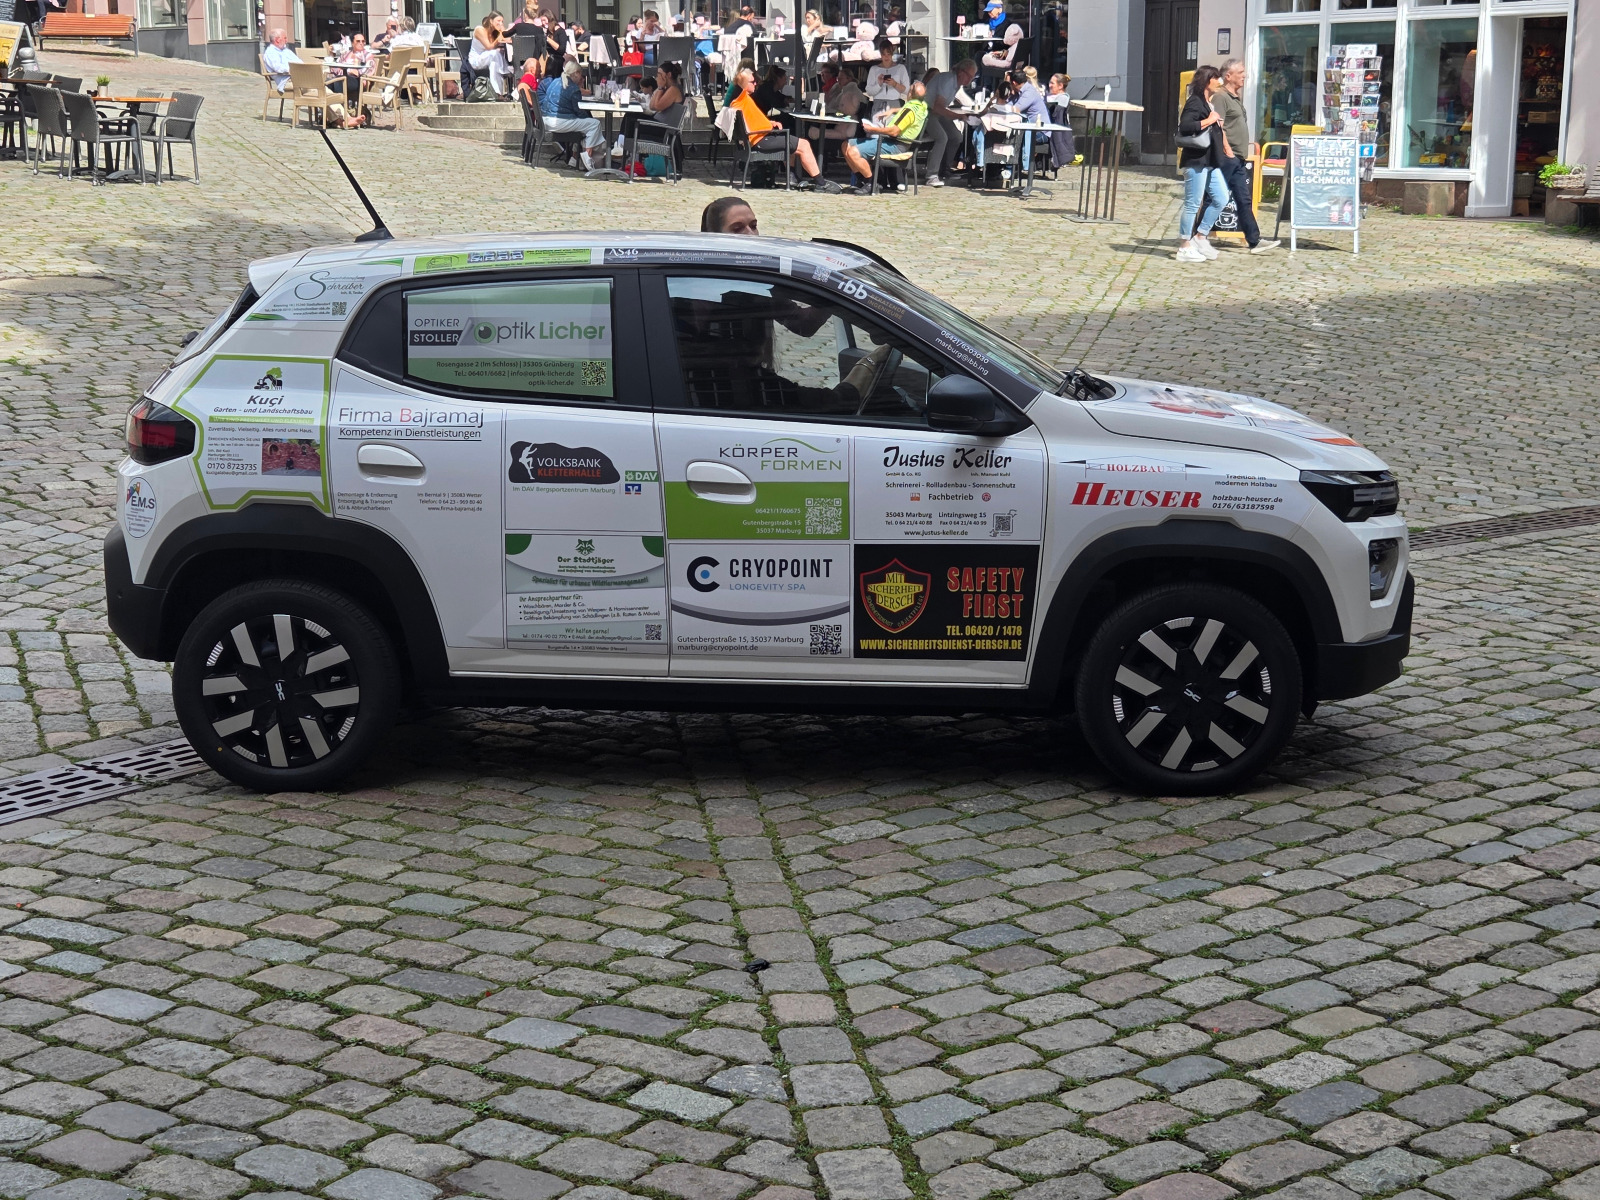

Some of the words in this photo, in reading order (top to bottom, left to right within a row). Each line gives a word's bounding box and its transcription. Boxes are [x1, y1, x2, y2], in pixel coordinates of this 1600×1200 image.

[1300, 156, 1352, 168] IDEEN?
[1294, 176, 1356, 184] GESCHMACK!
[609, 248, 638, 256] AS46
[415, 319, 459, 327] OPTIKER
[539, 322, 605, 340] Licher
[413, 334, 459, 342] STOLLER
[941, 330, 989, 364] 06421/6203030
[935, 337, 989, 376] marburg@ibb.ing
[544, 361, 574, 369] Grünberg
[339, 408, 392, 422] Firma
[400, 408, 484, 428] Bajramaj
[339, 428, 391, 438] Kompetenz
[395, 428, 402, 436] in
[406, 428, 481, 439] Dienstleistungen
[720, 444, 798, 457] KÖRPER
[884, 446, 945, 468] Justus
[953, 448, 1011, 468] Keller
[537, 458, 601, 468] VOLKSBANK
[761, 460, 841, 470] FORMEN
[538, 469, 601, 477] KLETTERHALLE
[1107, 464, 1164, 473] HOLZBAU
[635, 472, 657, 481] DAV
[536, 486, 588, 494] Bergsportzentrum
[1070, 482, 1202, 508] HEUSER
[1213, 495, 1283, 503] holzbau-heuser.de
[730, 559, 832, 578] CRYOPOINT
[532, 576, 558, 585] Spezialist
[887, 574, 903, 583] MIT
[947, 567, 1024, 592] SAFETY
[868, 585, 920, 594] SICHERHEIT
[878, 594, 912, 609] DERSCH
[963, 594, 1023, 618] FIRST
[946, 625, 963, 636] TEL.
[965, 625, 993, 636] 06420
[1003, 626, 1022, 636] 1478
[677, 636, 736, 644] Gutenbergstraße
[860, 640, 1022, 650] WWW.SICHERHEITSDIENST-DERSCH.DE
[677, 644, 758, 652] marburg@cryopoint.de
